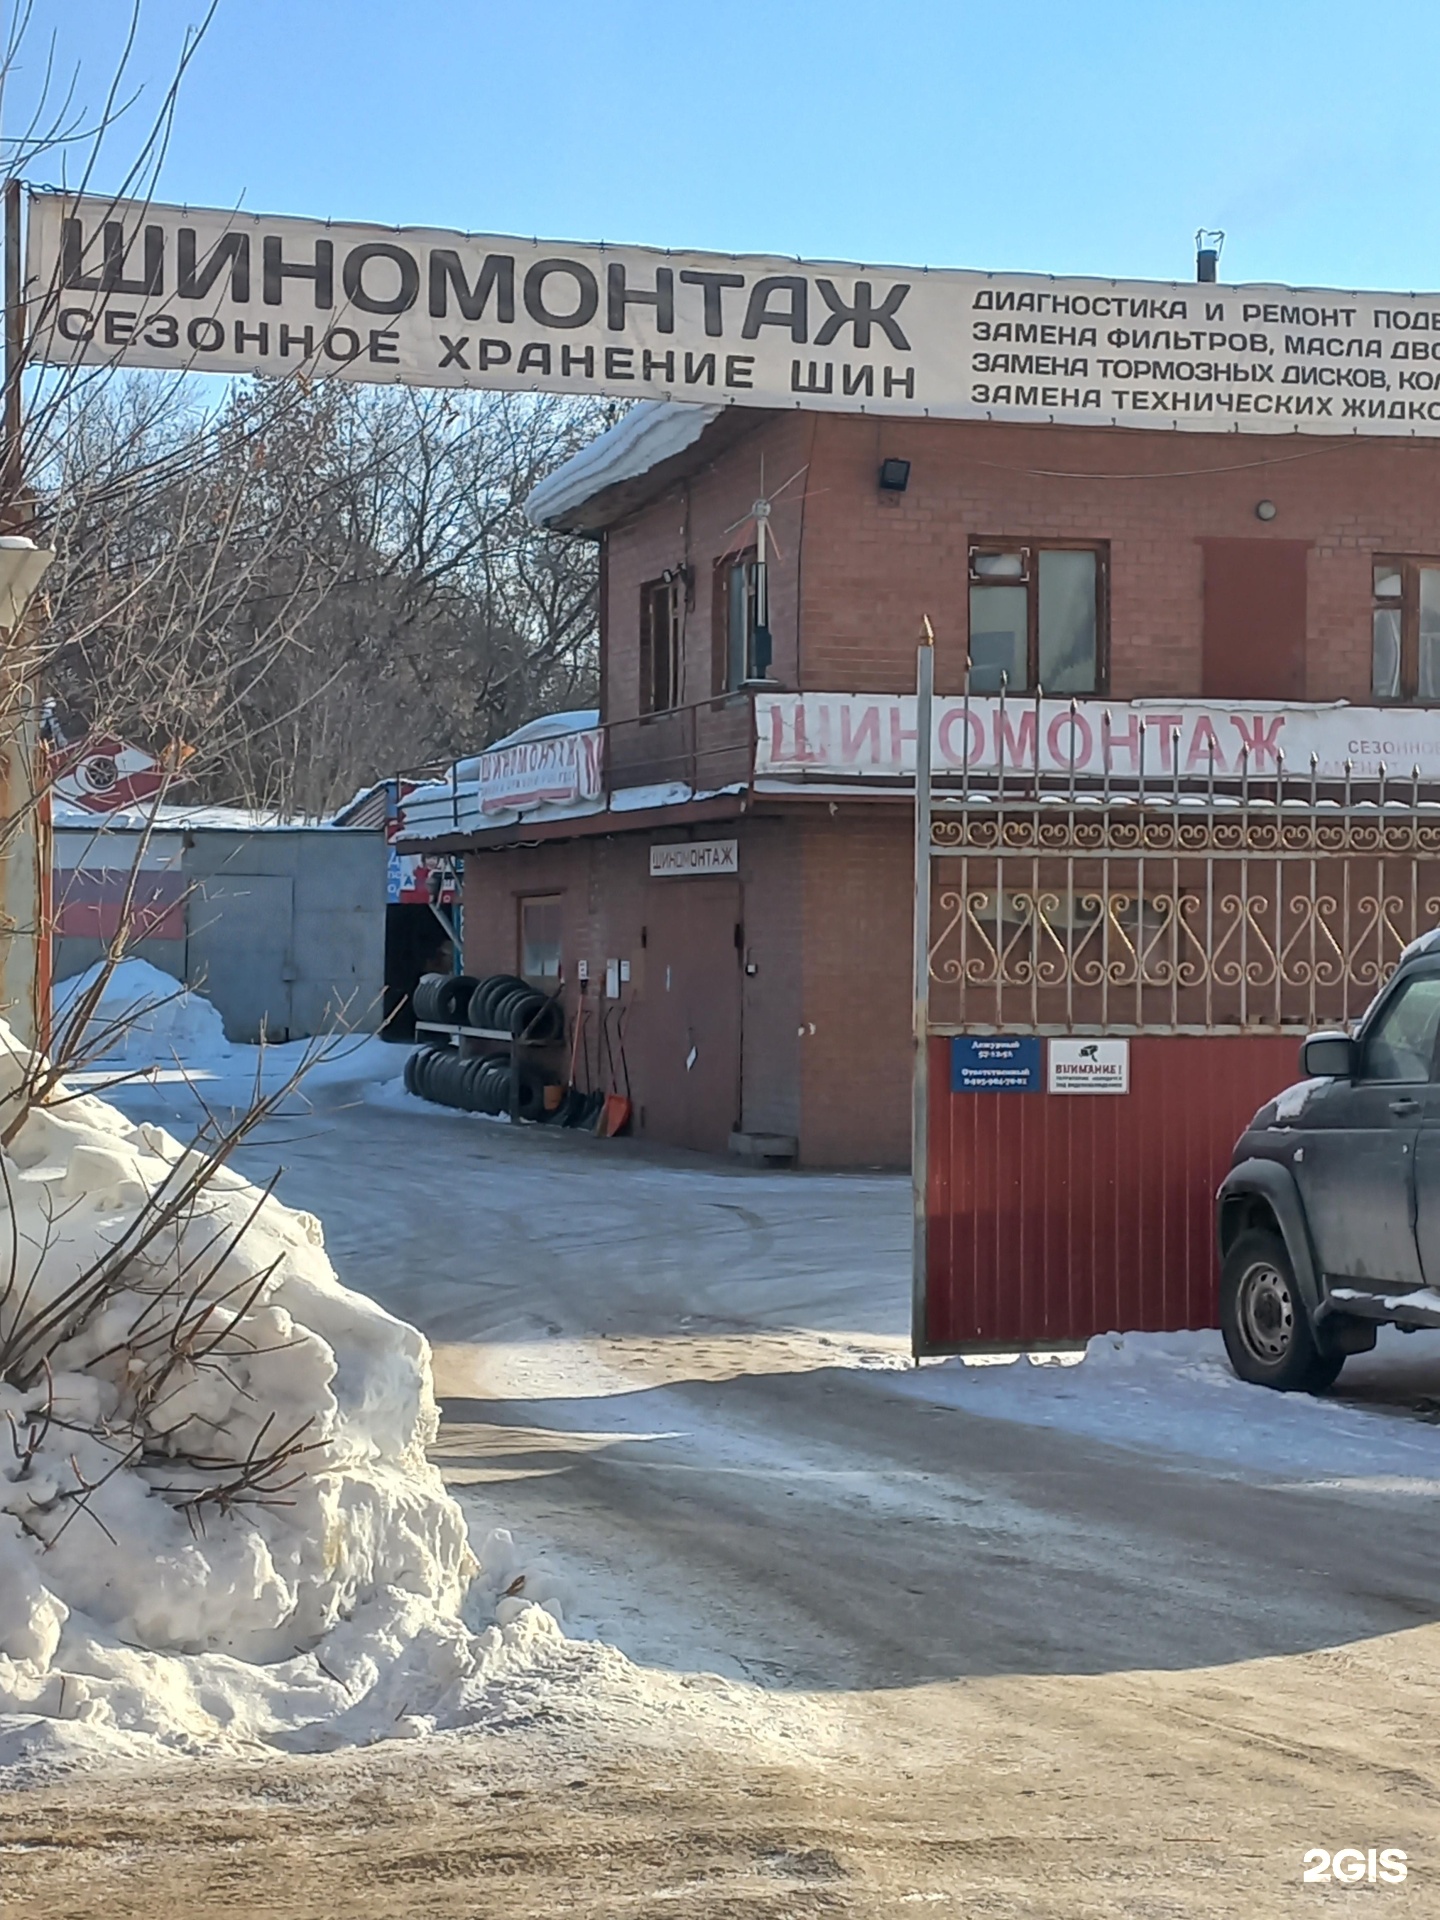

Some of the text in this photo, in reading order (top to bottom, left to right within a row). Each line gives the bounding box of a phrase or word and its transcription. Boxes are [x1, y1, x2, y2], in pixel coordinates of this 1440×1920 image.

[62, 217, 912, 351] ШИНОМОНТАЖ
[972, 290, 1188, 319] ДИАГНОСТИКА
[1205, 302, 1224, 321] И
[1243, 304, 1357, 328] РЕМОНТ
[58, 307, 915, 399] СЕЗОННОЕ ХРАНЕНИЕ ШИН
[972, 321, 1097, 347] ЗАМЕНА
[1107, 327, 1275, 356] ФИЛЬТРОВ,
[1285, 334, 1382, 359] МАСЛА
[971, 352, 1089, 377] ЗАМЕНА
[1096, 358, 1274, 383] ТОРМОЗНЫХ
[1281, 365, 1391, 392] ДИСКОВ,
[971, 384, 1101, 408] ЗАМЕНА
[1111, 390, 1333, 417] ТЕХНИЧЕСКИХ
[770, 703, 1288, 774] ШИНОМОНТАЖ
[652, 847, 734, 869] ШИНОМОНТАЖ
